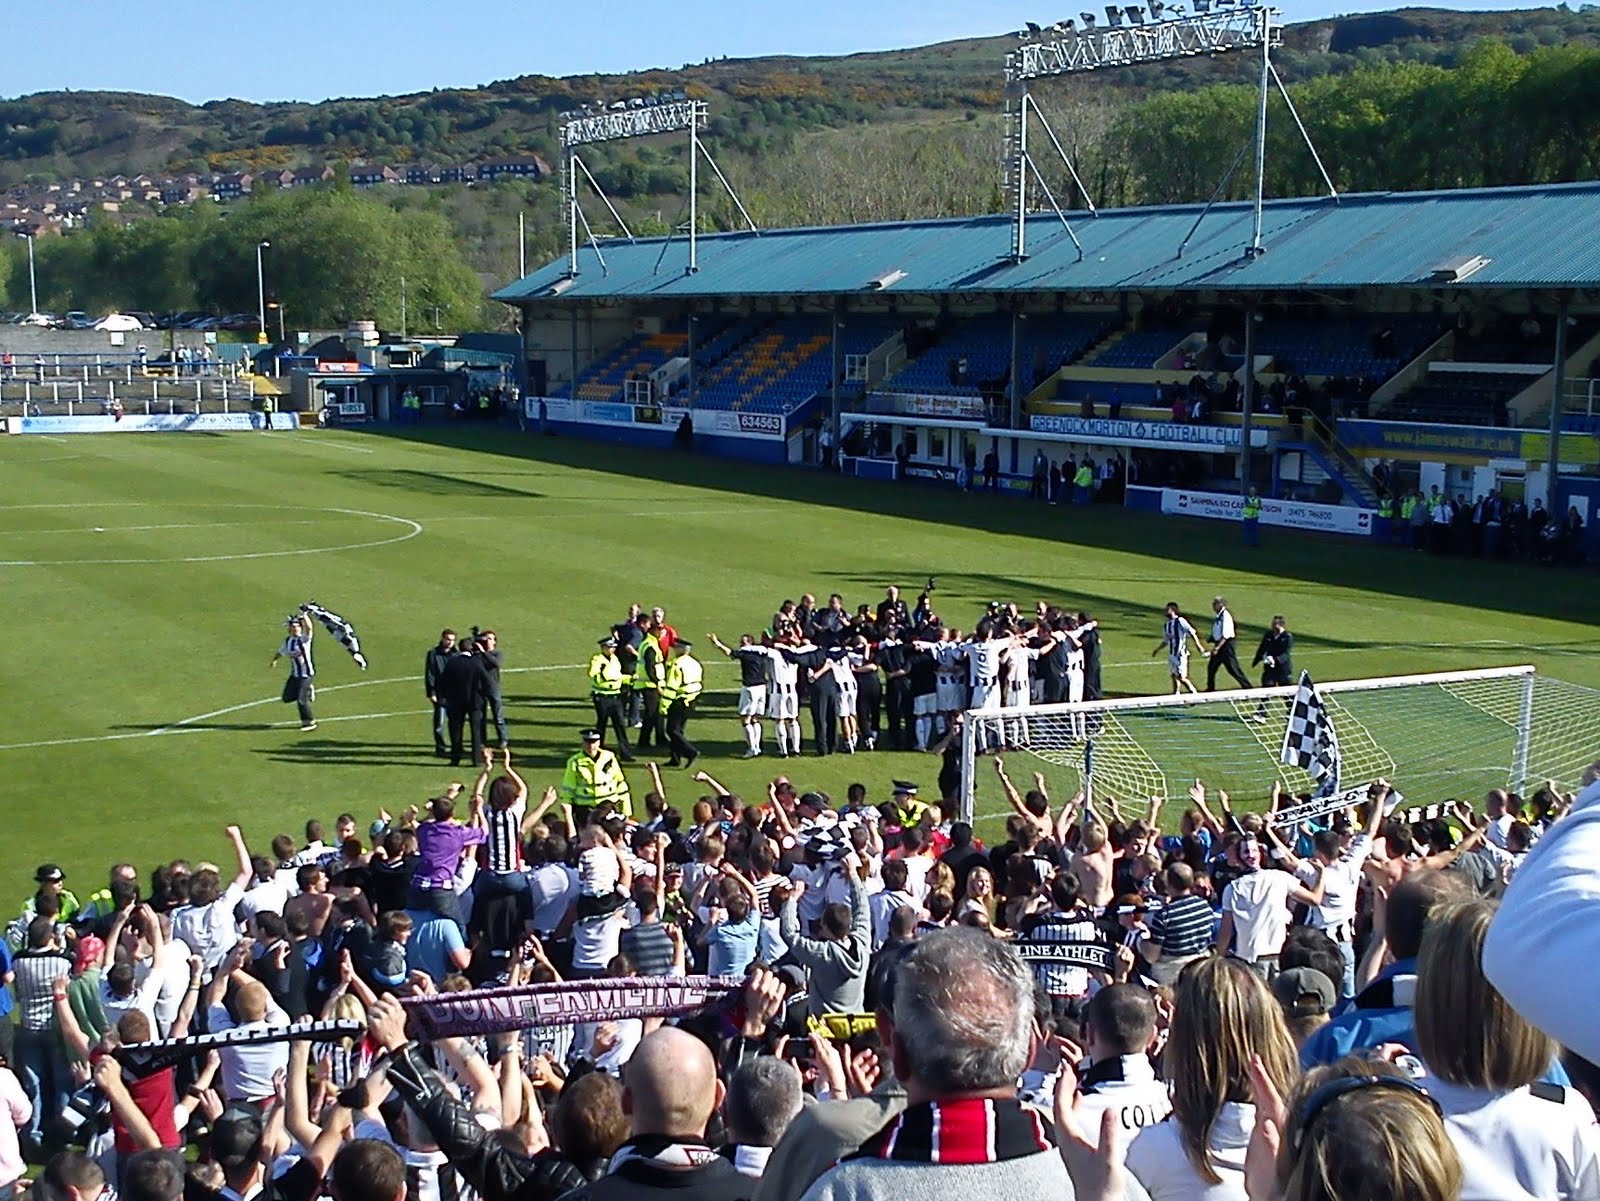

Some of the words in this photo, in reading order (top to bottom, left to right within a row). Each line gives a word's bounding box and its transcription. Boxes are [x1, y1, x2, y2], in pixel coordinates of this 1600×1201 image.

[741, 415, 780, 430] 634563
[1032, 416, 1087, 433] GREENOCK
[1088, 420, 1132, 437] MORTON
[1151, 424, 1213, 443] FOOTBALL
[1215, 428, 1241, 445] CLU
